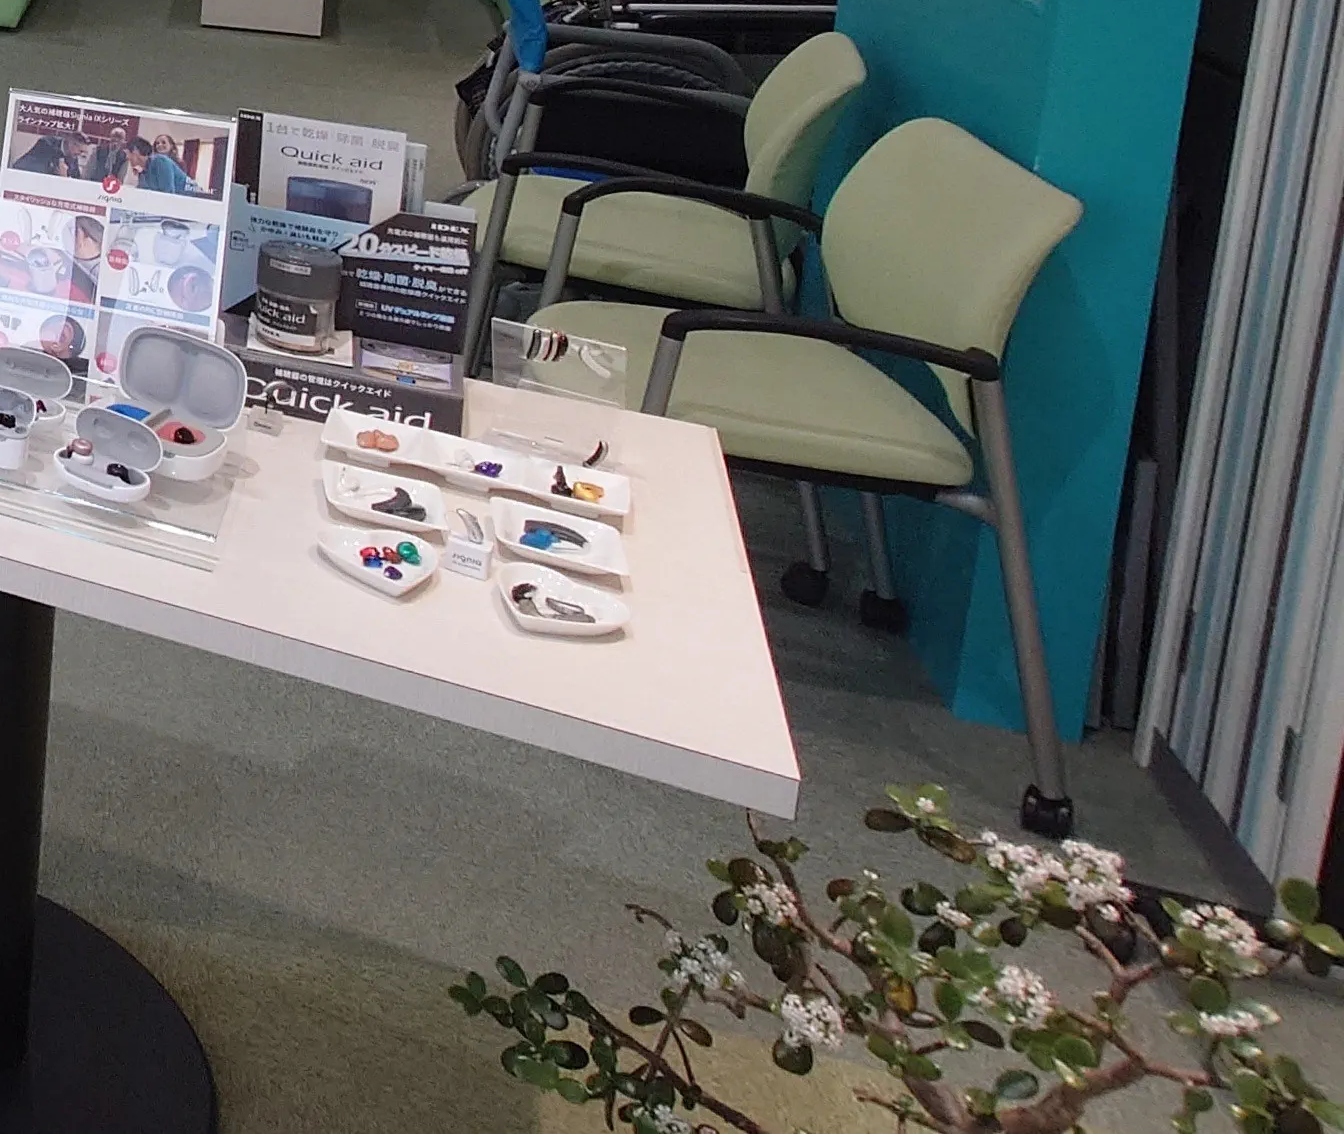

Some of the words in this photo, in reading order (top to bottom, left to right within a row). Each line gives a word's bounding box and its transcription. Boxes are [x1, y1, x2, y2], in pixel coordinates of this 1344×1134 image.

[280, 145, 343, 165] Quick
[349, 158, 384, 171] aid
[97, 194, 123, 204] signia
[430, 222, 470, 234] IDEX
[282, 313, 306, 324] aid
[274, 367, 392, 399] 補聴器の管理はクイックエイド
